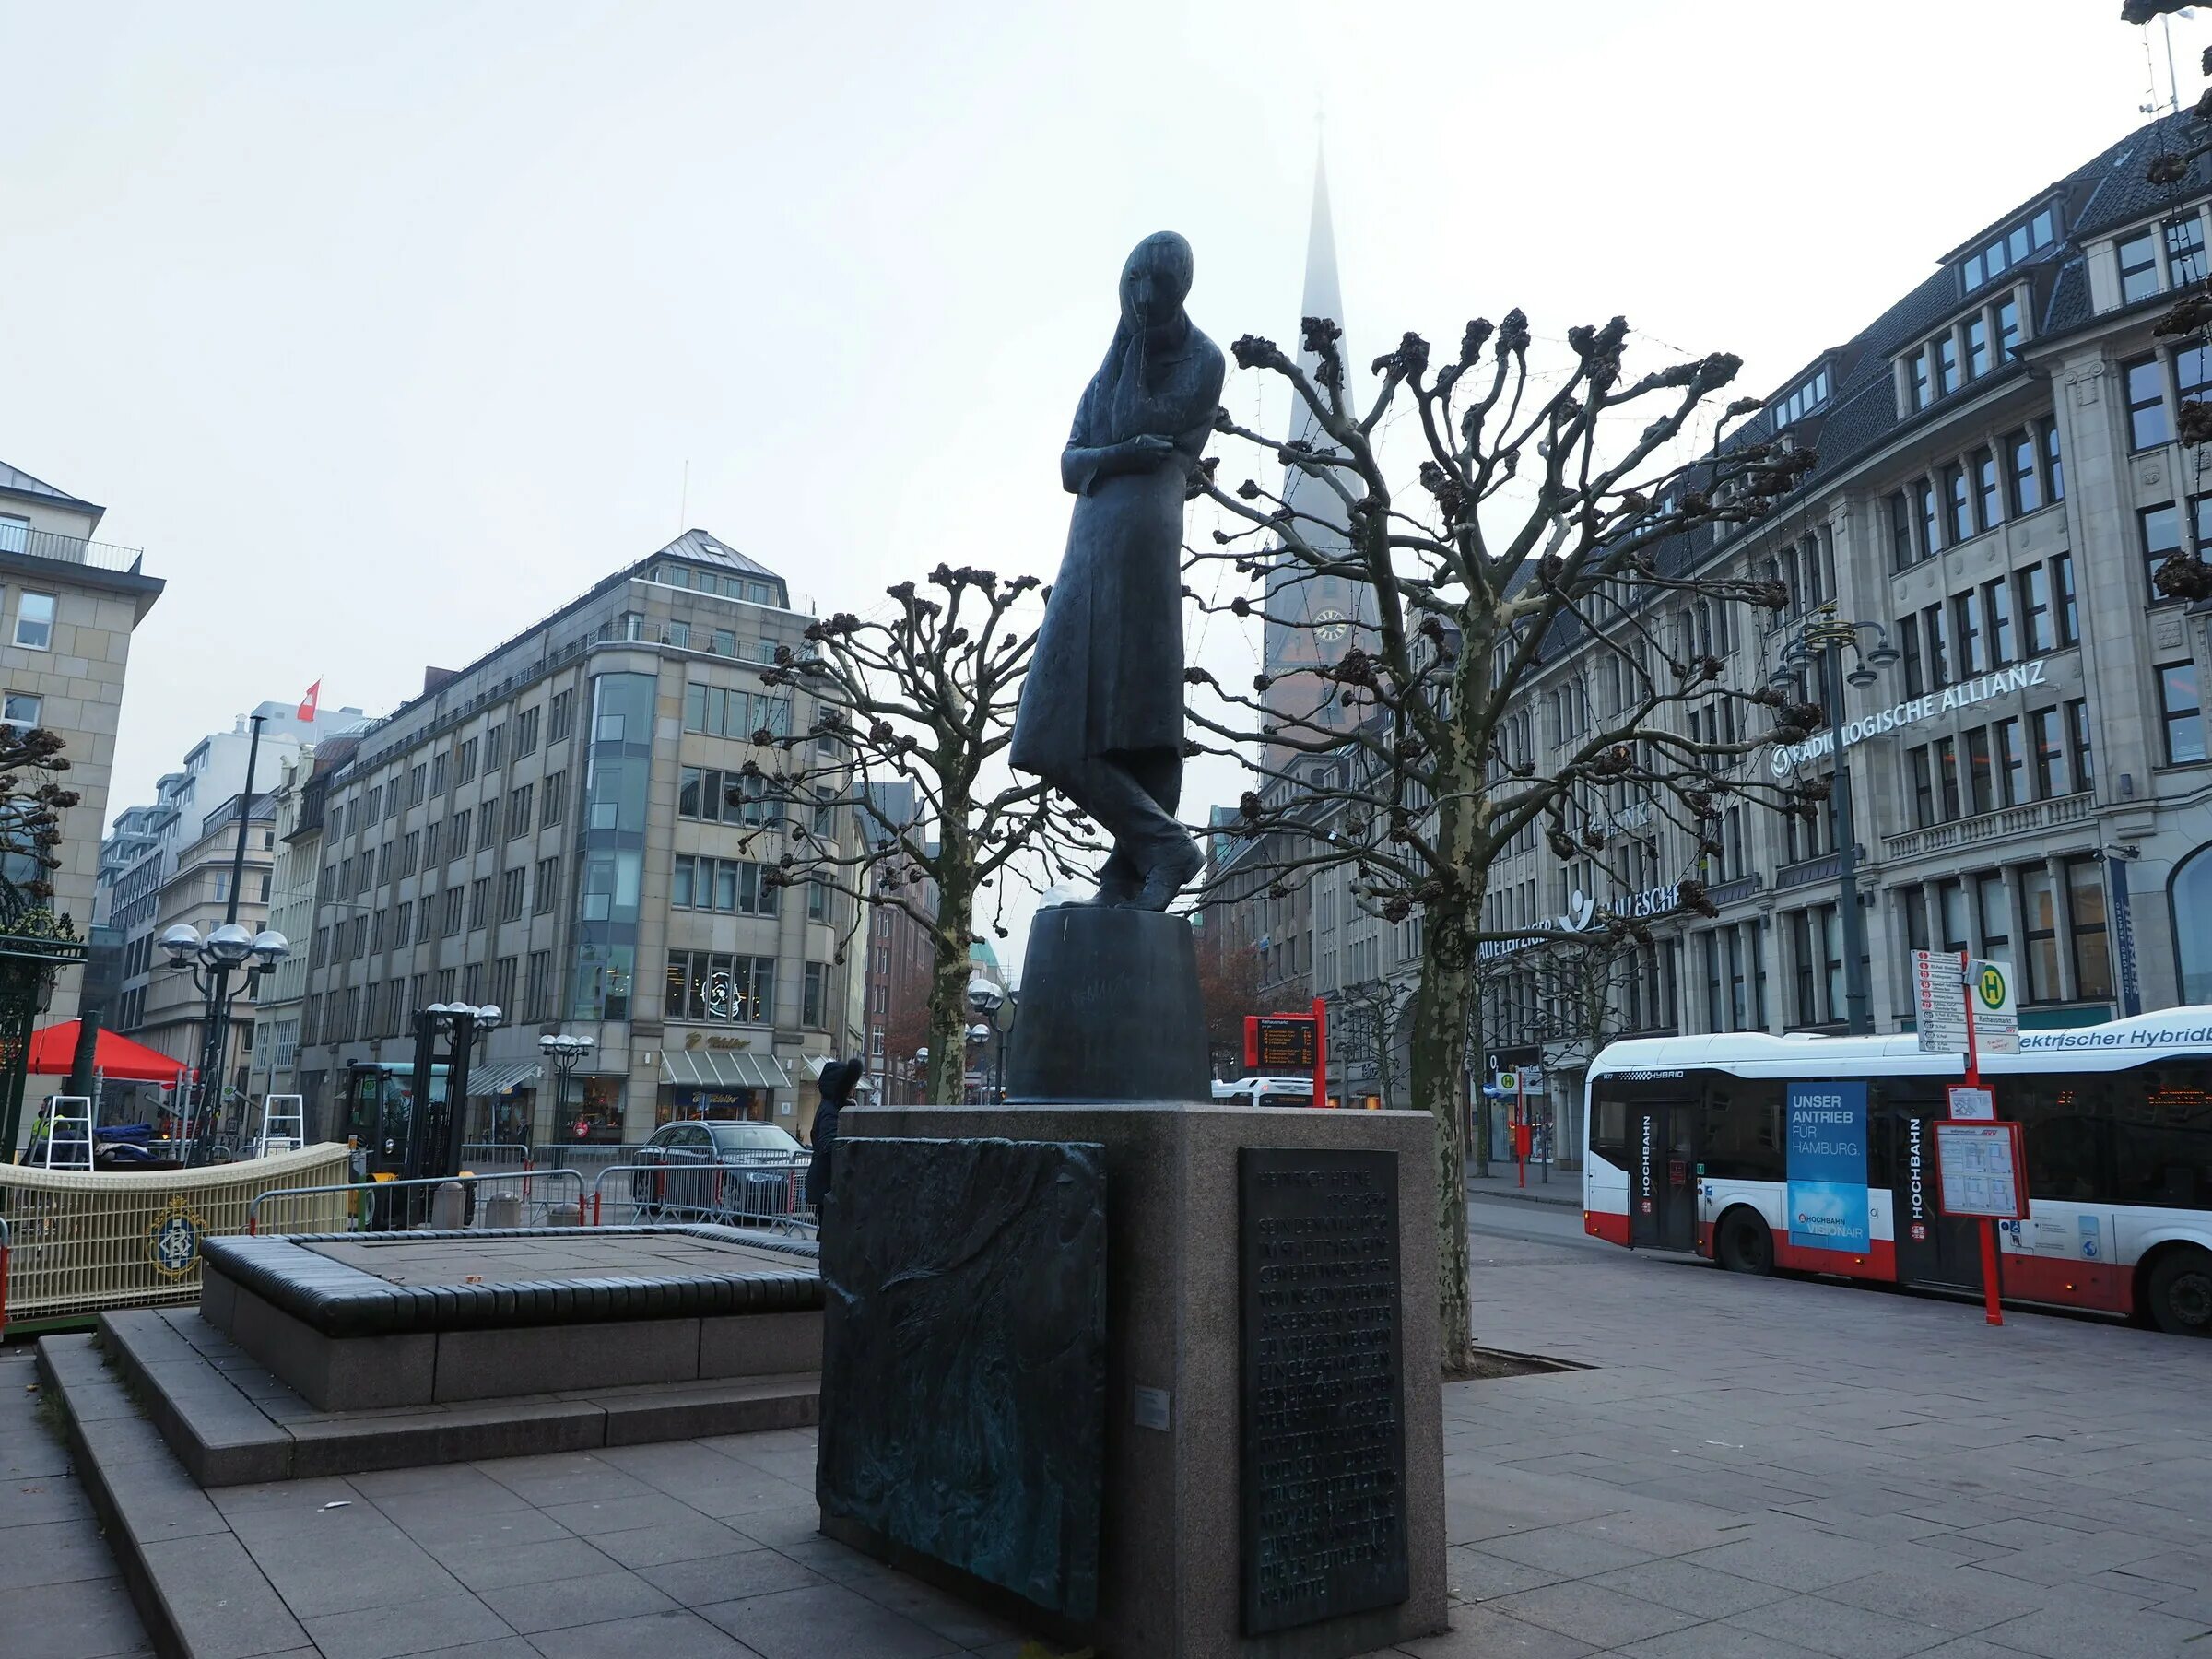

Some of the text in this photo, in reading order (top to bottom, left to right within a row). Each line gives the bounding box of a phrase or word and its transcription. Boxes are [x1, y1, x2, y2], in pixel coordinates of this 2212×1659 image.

[1940, 659, 2046, 713] ALLIANZ
[1984, 975, 1999, 1000] H
[2019, 1032, 2125, 1048] ektrischer
[1650, 1070, 1684, 1079] HYBRID
[1793, 1095, 1841, 1108] UNSER
[1792, 1111, 1853, 1124] ANTRIEB
[1793, 1124, 1817, 1138] FÜR
[1642, 1115, 1651, 1196] HOCHBAHN
[1792, 1141, 1861, 1156] HAMBURG.
[1910, 1118, 1923, 1219] HOCHBAHN
[1331, 1169, 1372, 1187] HEINE
[1806, 1216, 1845, 1225] HOCHBAHN
[1807, 1223, 1864, 1239] VISIONAIR
